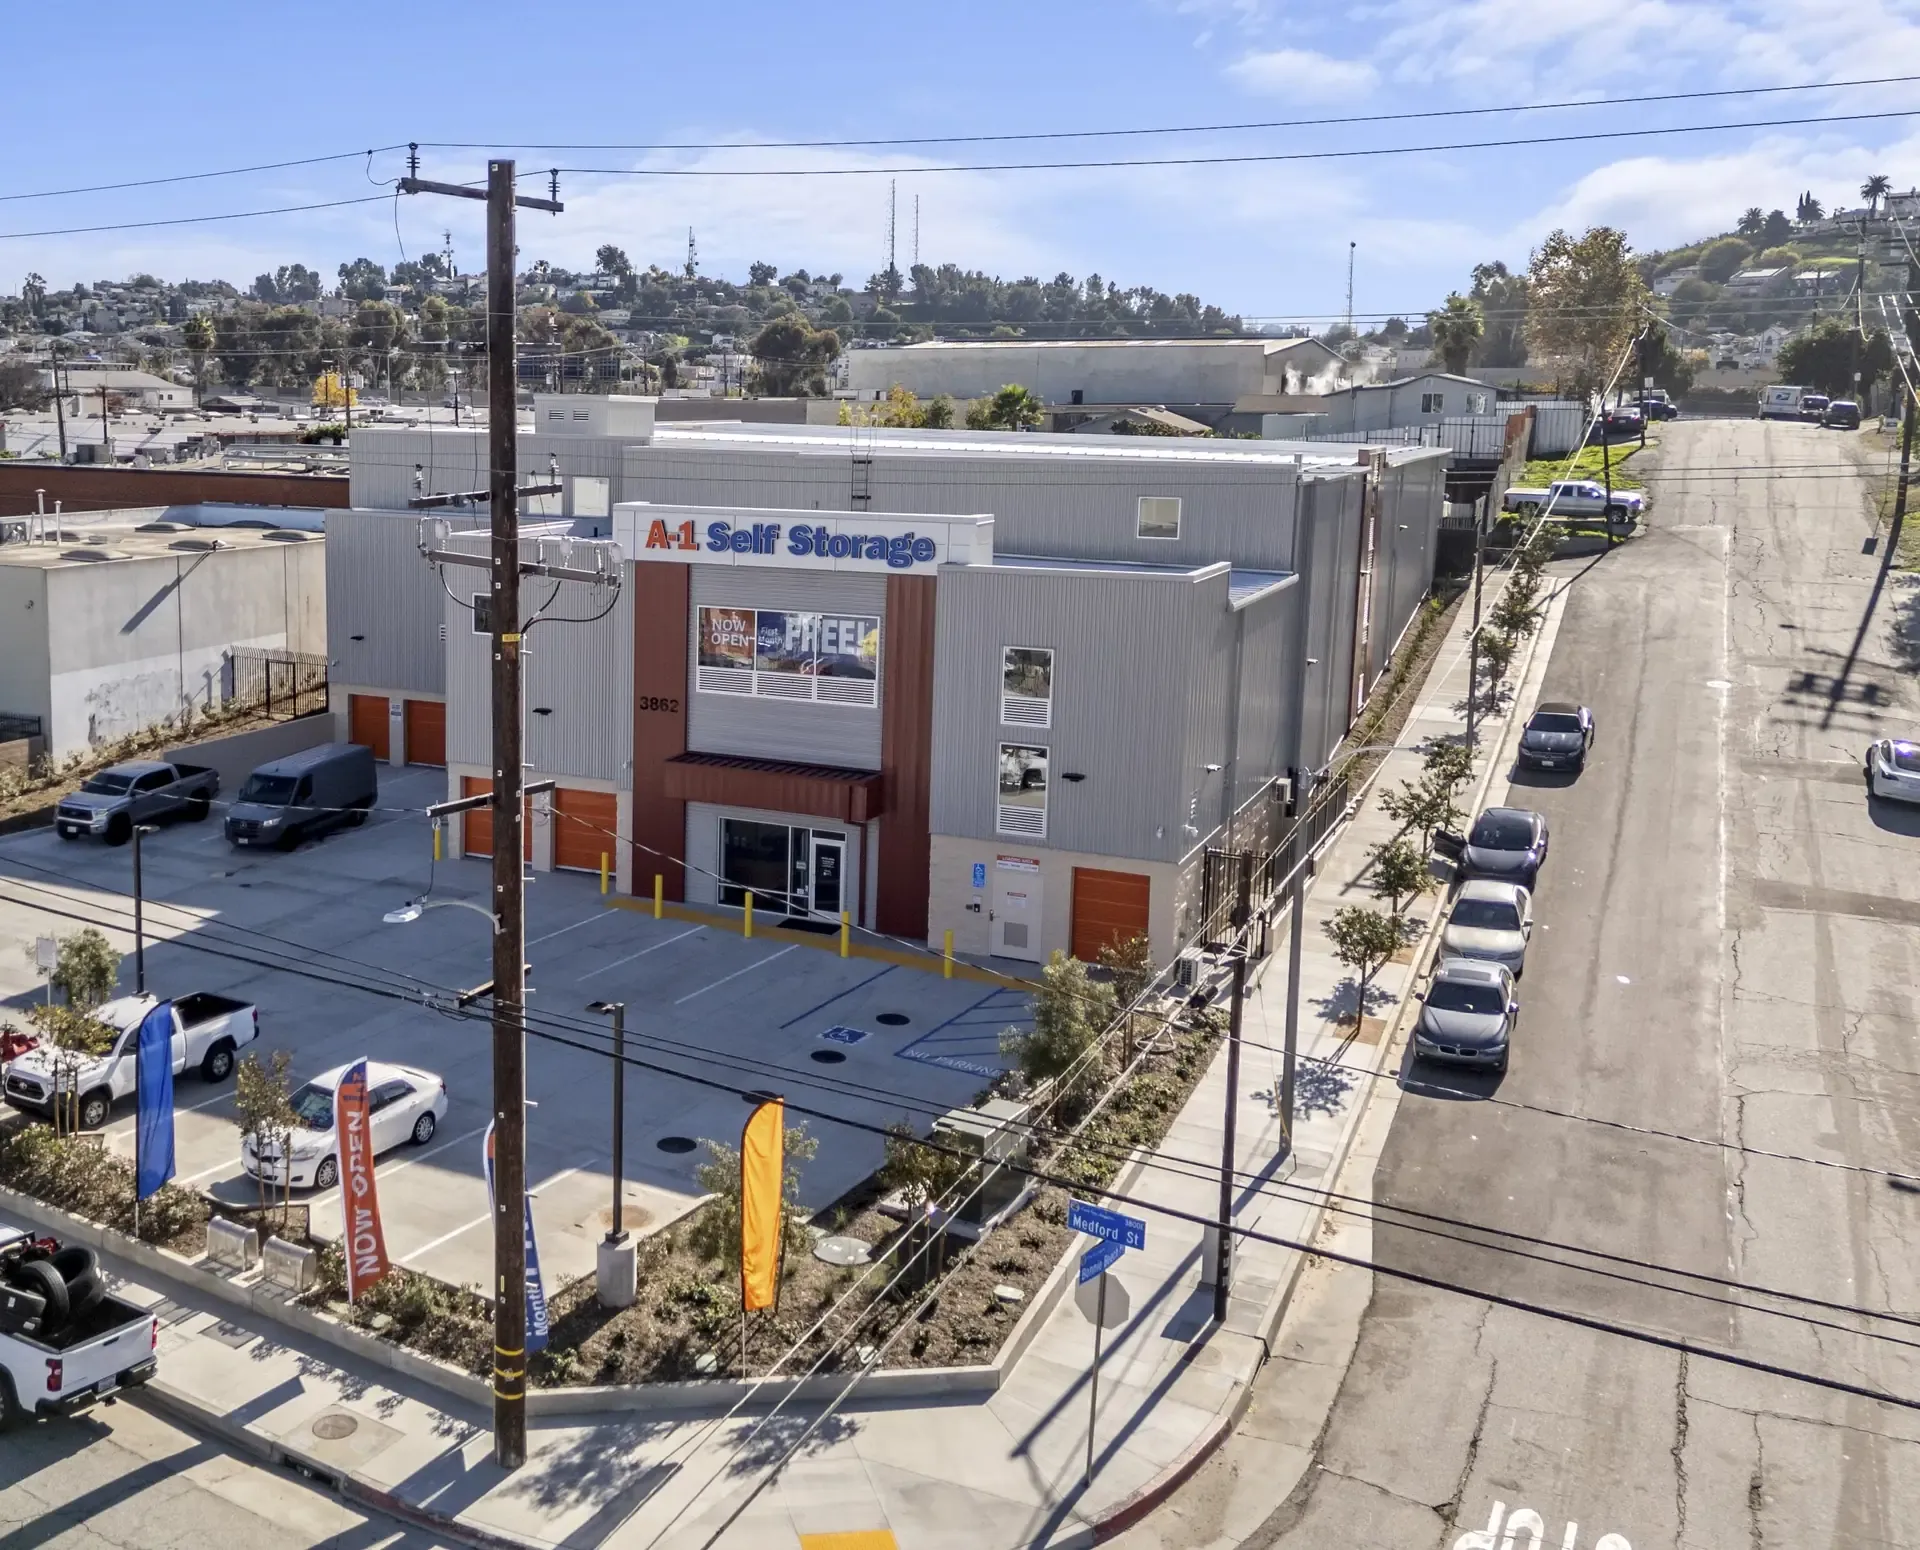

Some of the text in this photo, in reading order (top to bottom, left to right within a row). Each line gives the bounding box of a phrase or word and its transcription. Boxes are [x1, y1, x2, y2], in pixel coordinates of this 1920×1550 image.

[645, 519, 935, 568] A-1 Self Storage
[711, 618, 747, 632] NOW
[711, 632, 749, 647] OPEN
[640, 696, 679, 713] 3862
[347, 1111, 369, 1198] OPEN
[354, 1204, 381, 1278] NOW
[1072, 1214, 1139, 1246] Medford St
